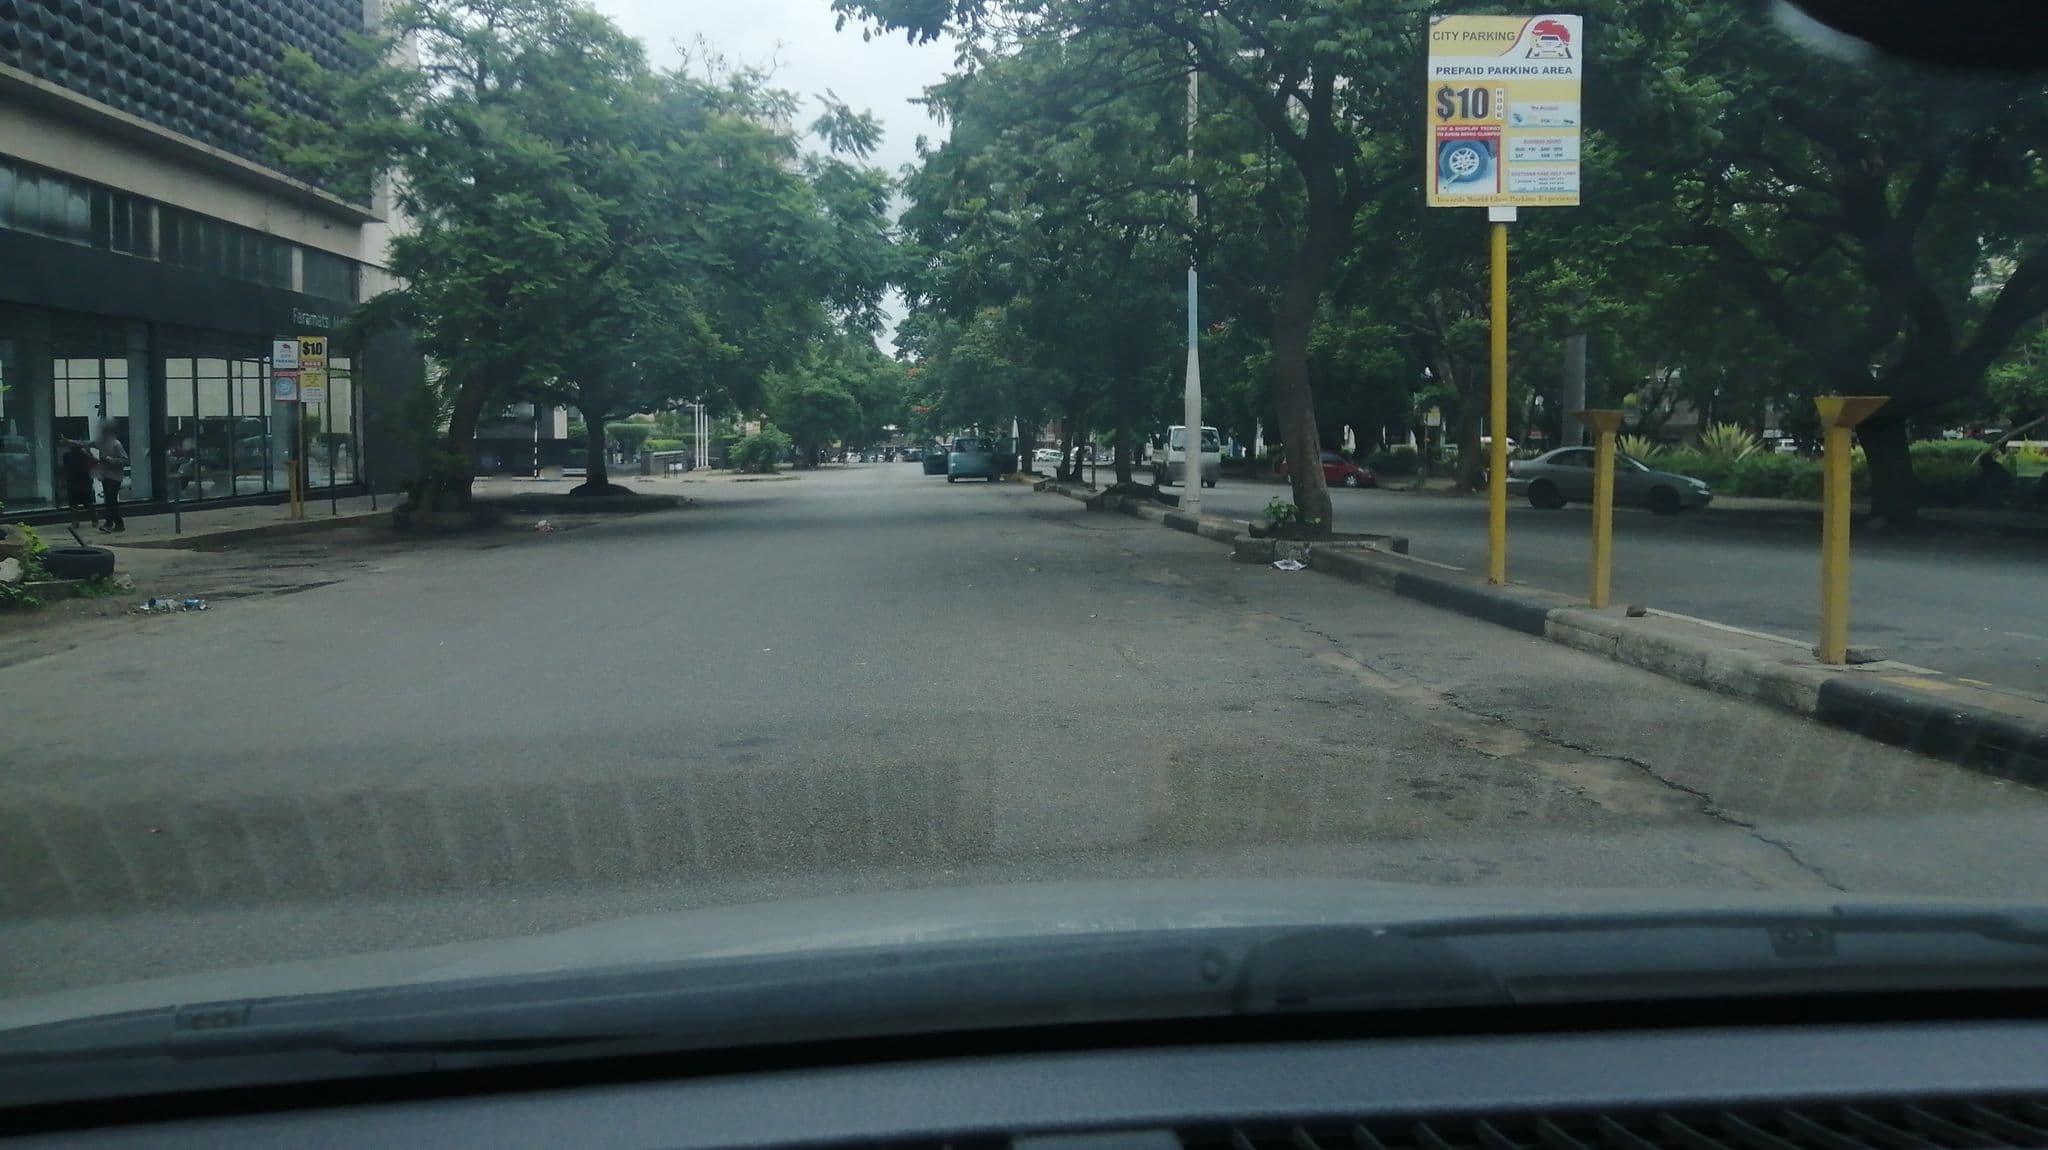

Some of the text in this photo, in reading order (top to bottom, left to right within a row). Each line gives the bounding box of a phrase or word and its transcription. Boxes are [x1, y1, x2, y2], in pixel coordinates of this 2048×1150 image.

[1432, 31, 1516, 41] CITY PARKING
[1436, 66, 1573, 75] PREPAID PARKING AREA
[1437, 85, 1489, 121] $10
[302, 341, 323, 356] $10
